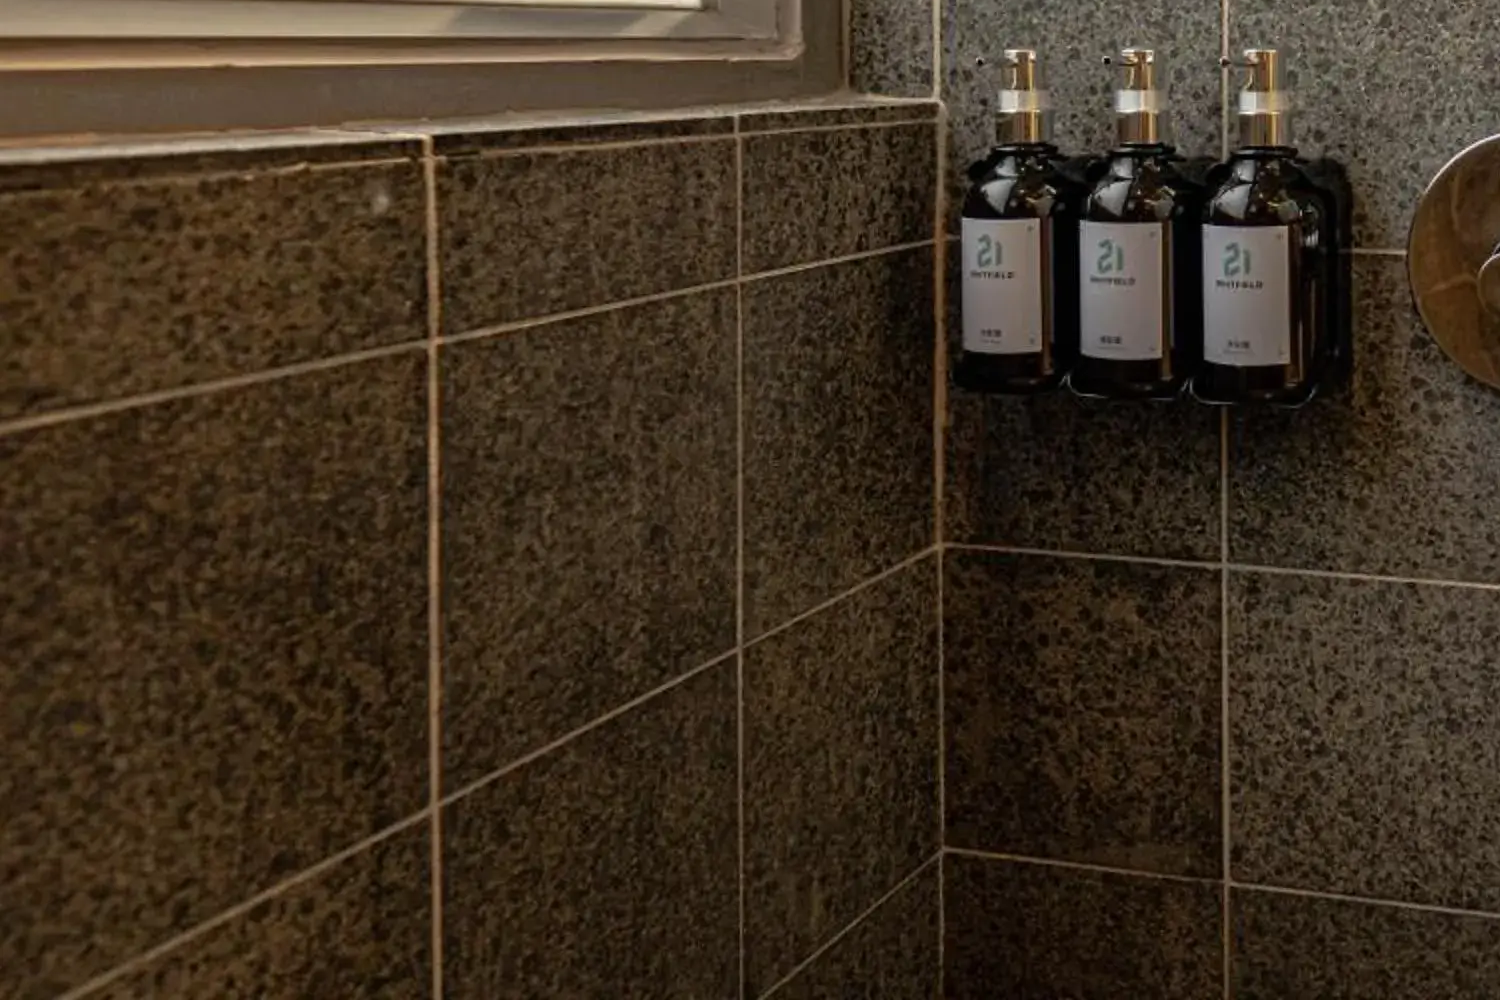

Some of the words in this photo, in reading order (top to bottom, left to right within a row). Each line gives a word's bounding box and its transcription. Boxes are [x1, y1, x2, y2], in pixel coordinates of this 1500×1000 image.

[978, 234, 1002, 267] 21
[1098, 239, 1123, 273] 21
[1224, 242, 1250, 276] 21
